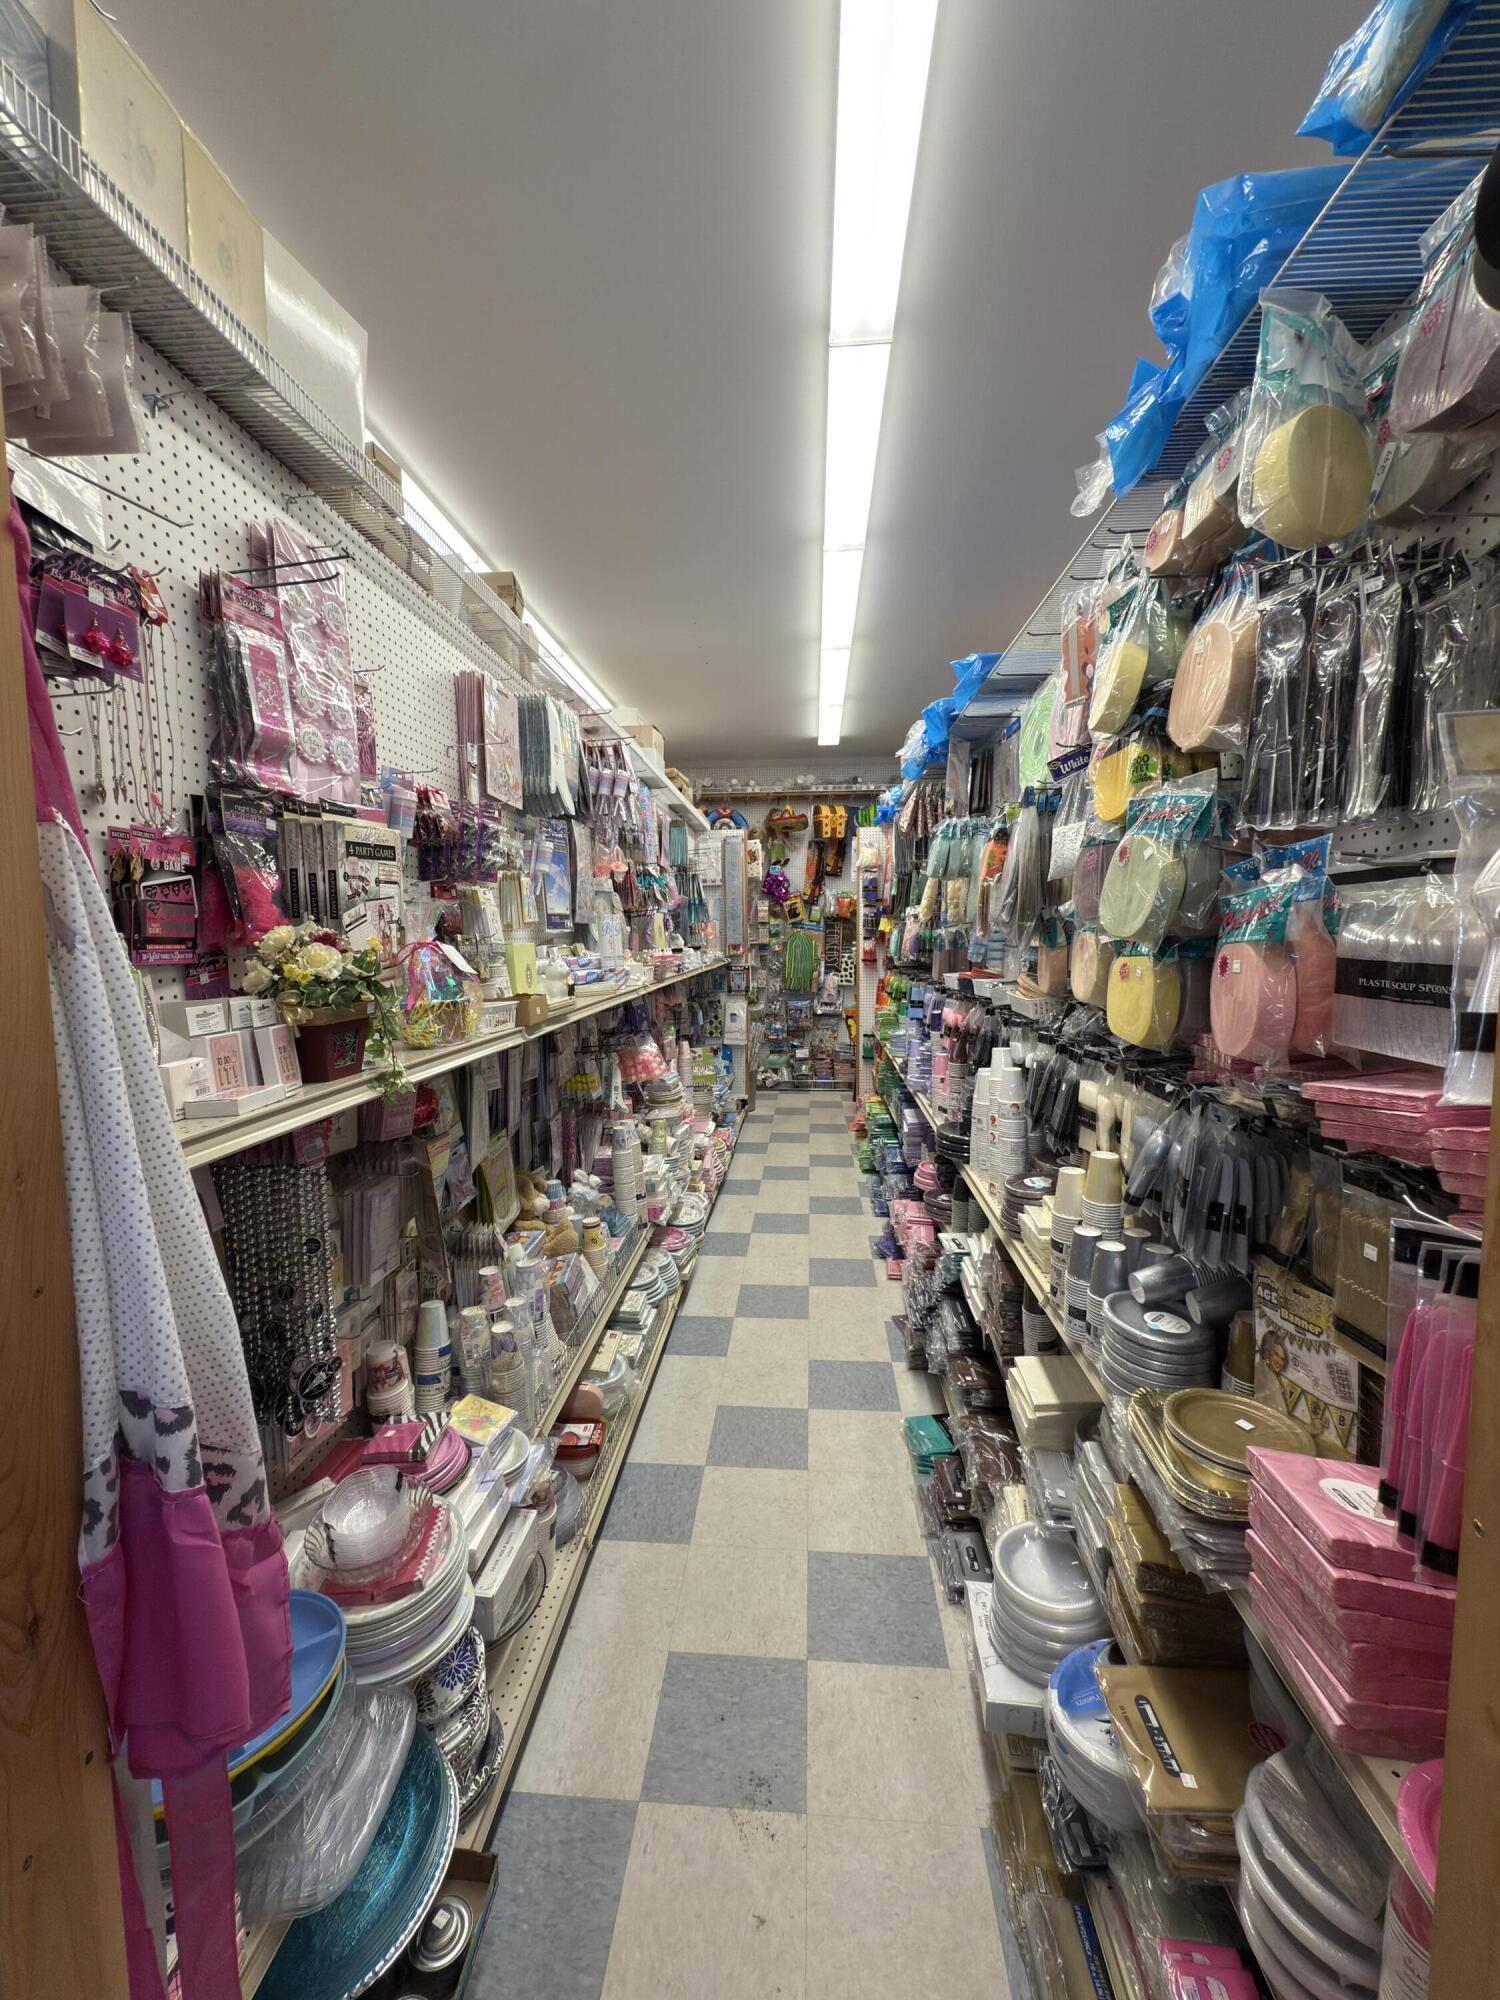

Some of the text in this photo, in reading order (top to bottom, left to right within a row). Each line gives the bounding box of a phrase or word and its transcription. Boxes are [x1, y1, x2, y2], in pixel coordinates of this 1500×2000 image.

[1059, 755, 1089, 774] White
[348, 844, 394, 859] 4 PARTY GAMES
[163, 859, 186, 873] GAME
[1391, 981, 1416, 991] SOUP
[1256, 1286, 1278, 1304] AGE
[1280, 1306, 1324, 1338] Banner
